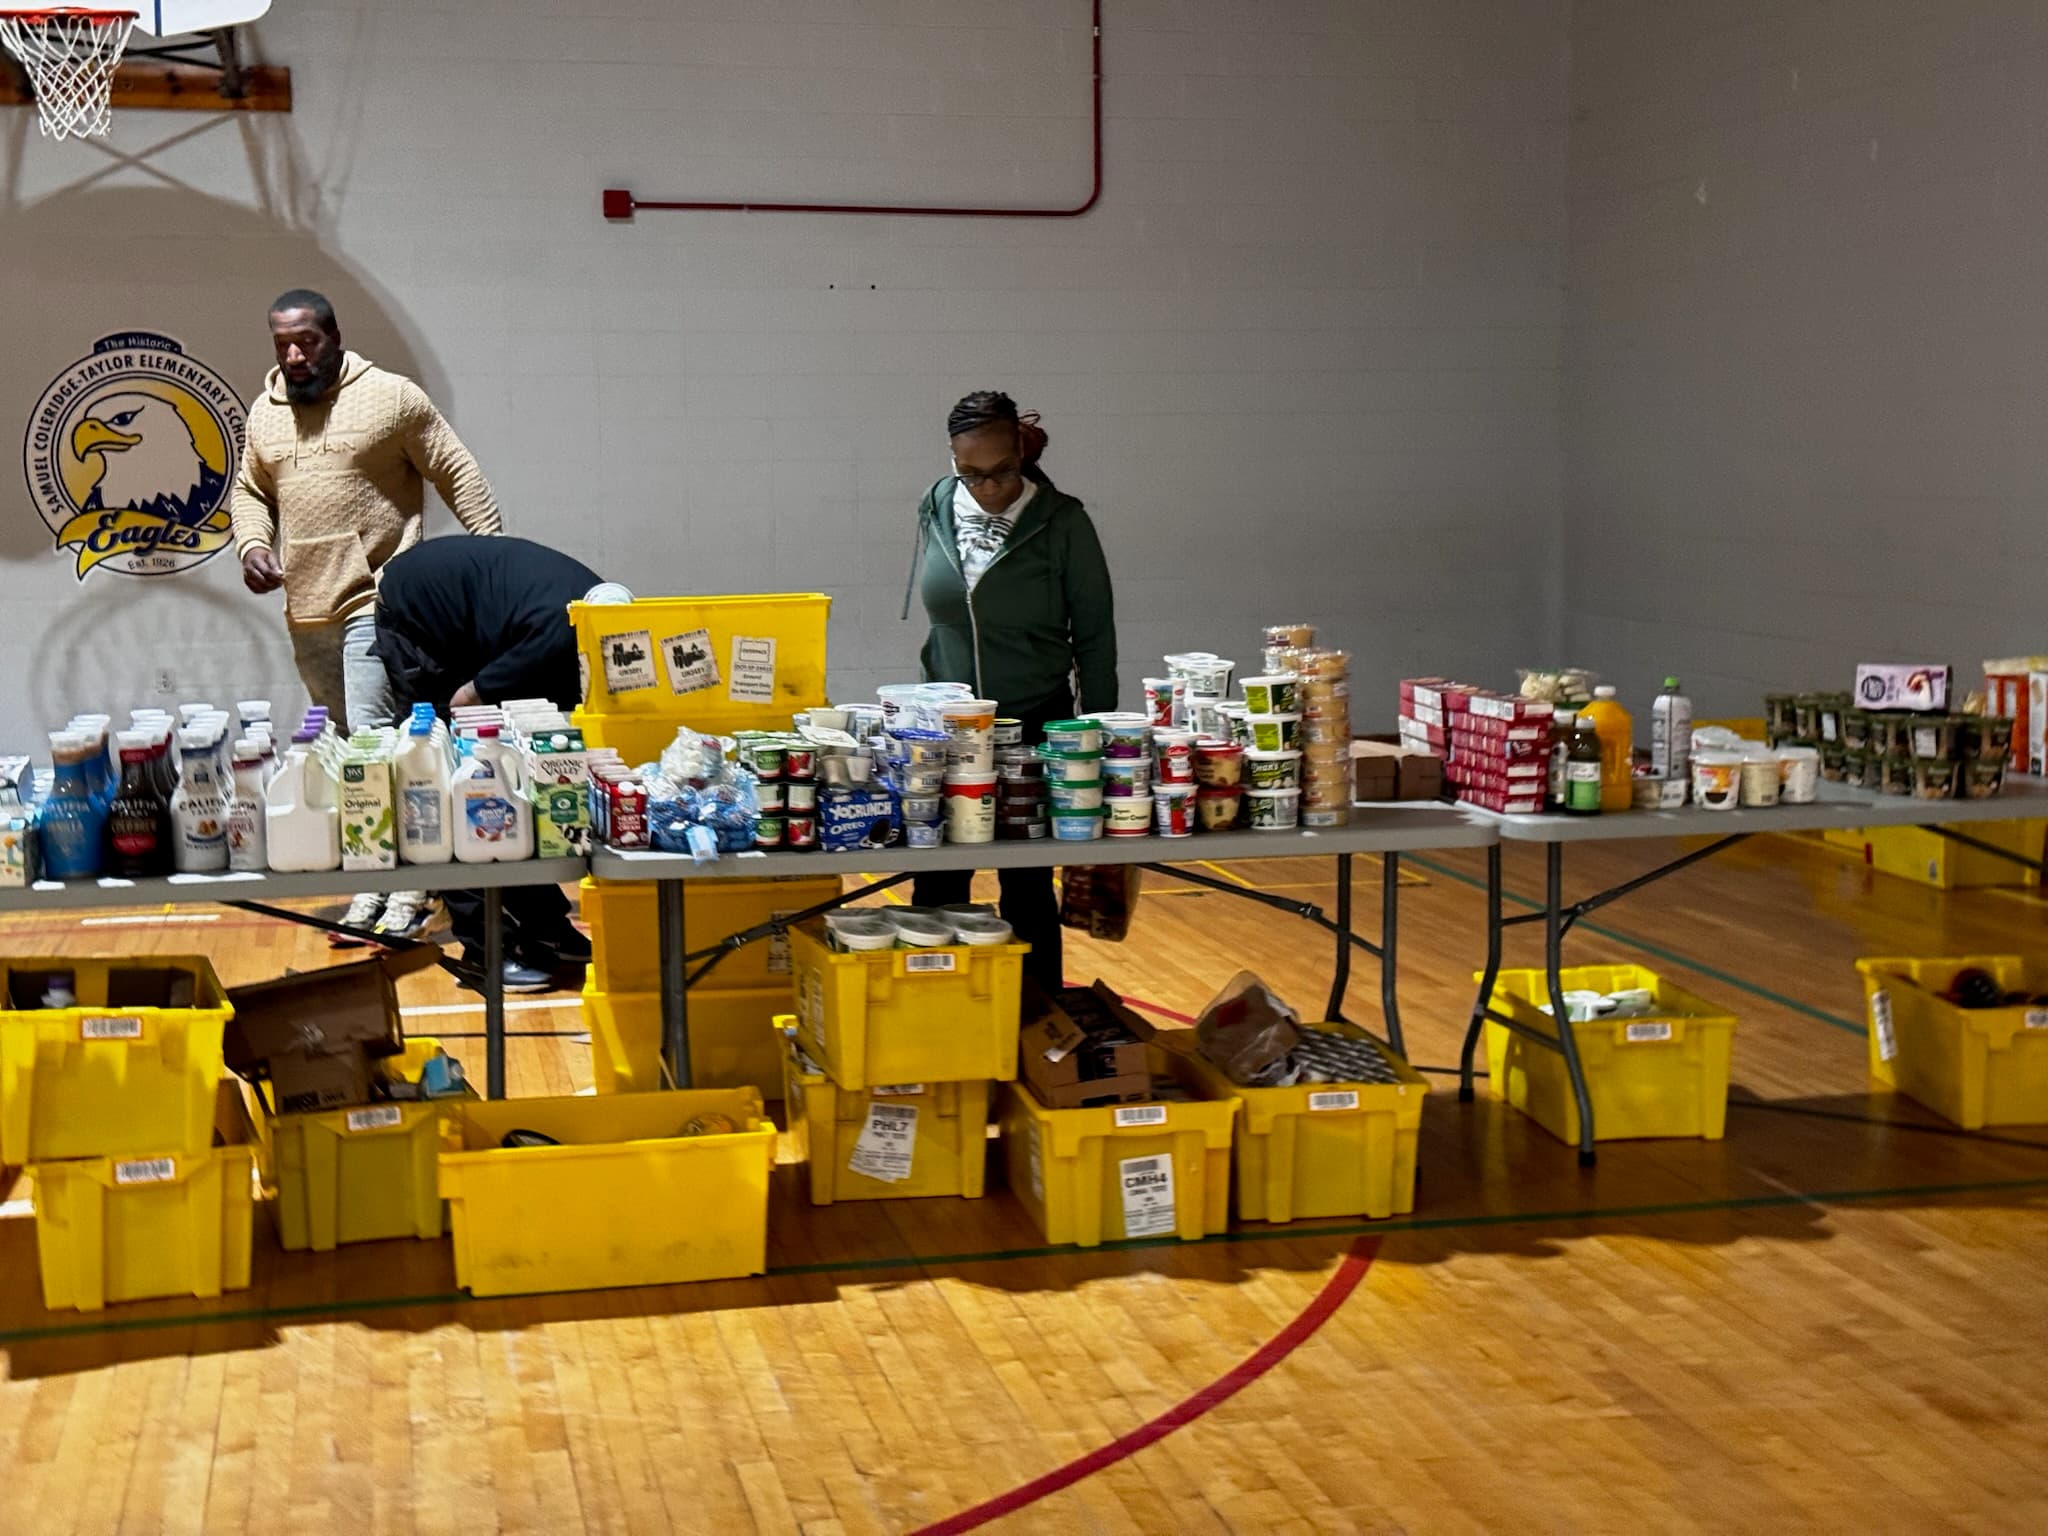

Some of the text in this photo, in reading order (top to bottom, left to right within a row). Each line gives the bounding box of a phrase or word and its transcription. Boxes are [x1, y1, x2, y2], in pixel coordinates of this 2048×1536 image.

[104, 336, 171, 350] The Historic
[140, 354, 229, 405] ELEMENTARY
[34, 354, 134, 451] COLERIDGE-TAYLOR
[34, 456, 64, 514] SAMUEL
[87, 510, 200, 556] Eagles
[152, 558, 175, 568] 1926
[541, 759, 584, 770] ORGANIC
[546, 766, 580, 777] VALLEY
[344, 799, 381, 809] Original
[829, 821, 866, 835] OREO
[1125, 1173, 1168, 1188] CMH4
